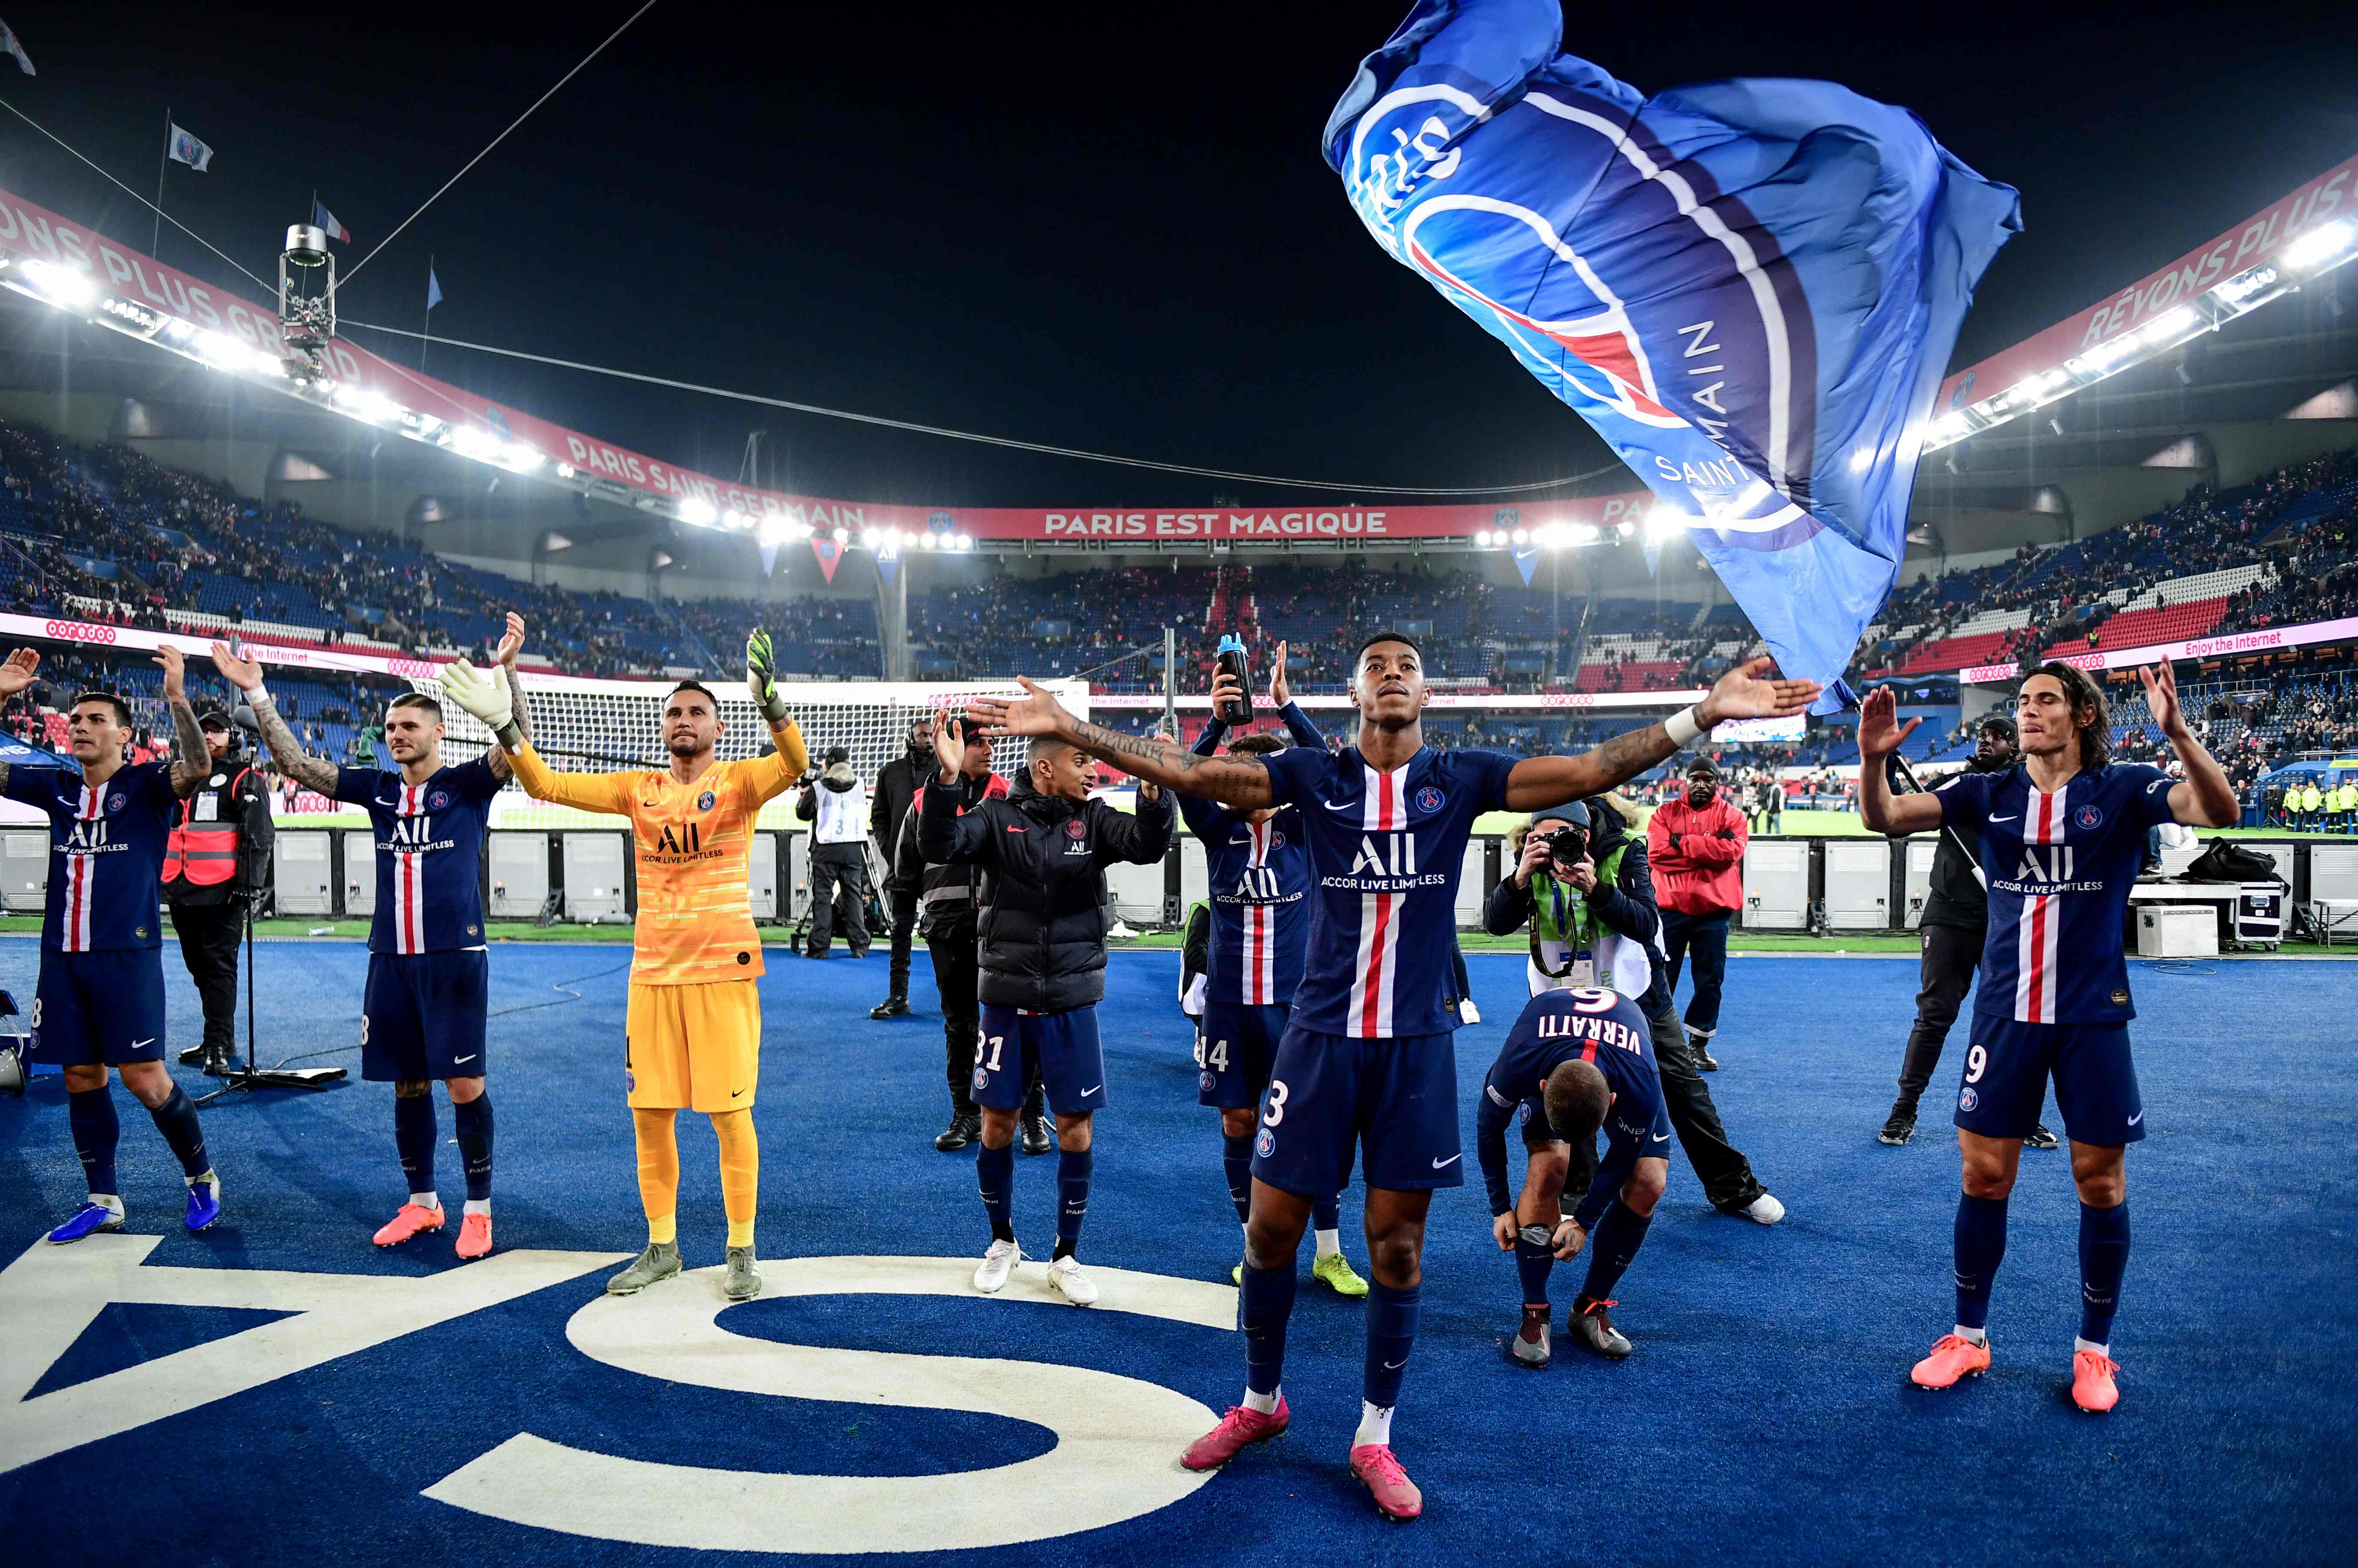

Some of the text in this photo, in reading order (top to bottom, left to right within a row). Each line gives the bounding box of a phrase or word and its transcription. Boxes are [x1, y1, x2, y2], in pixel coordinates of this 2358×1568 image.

[2081, 170, 2350, 347] RÊVONS PLUS
[98, 244, 220, 327] PLUS
[567, 435, 646, 484] PARIS
[1655, 451, 1750, 486] SAINT
[1045, 512, 1386, 535] PARIS EST MAGIQUE
[46, 620, 116, 643] ooredoo
[267, 644, 308, 662] Internet
[2186, 631, 2281, 657] Enjoy the Internet
[1970, 666, 2011, 681] ooredoo
[414, 840, 454, 852] LIMITLESS
[663, 856, 682, 864] LIVE
[683, 849, 723, 863] LIMITLESS
[1321, 874, 1445, 890] ACCOR LIVE LIMILESS
[1992, 880, 2103, 893] ACCOR LIVE LIMITLESS
[1217, 895, 1241, 903] ACCOR
[32, 998, 42, 1027] 8
[1539, 1015, 1641, 1056] VERRATTI
[1199, 1036, 1229, 1072] 14
[1965, 1045, 1987, 1084] 9
[1264, 1080, 1289, 1127] 3
[1618, 1116, 1645, 1135] QNB
